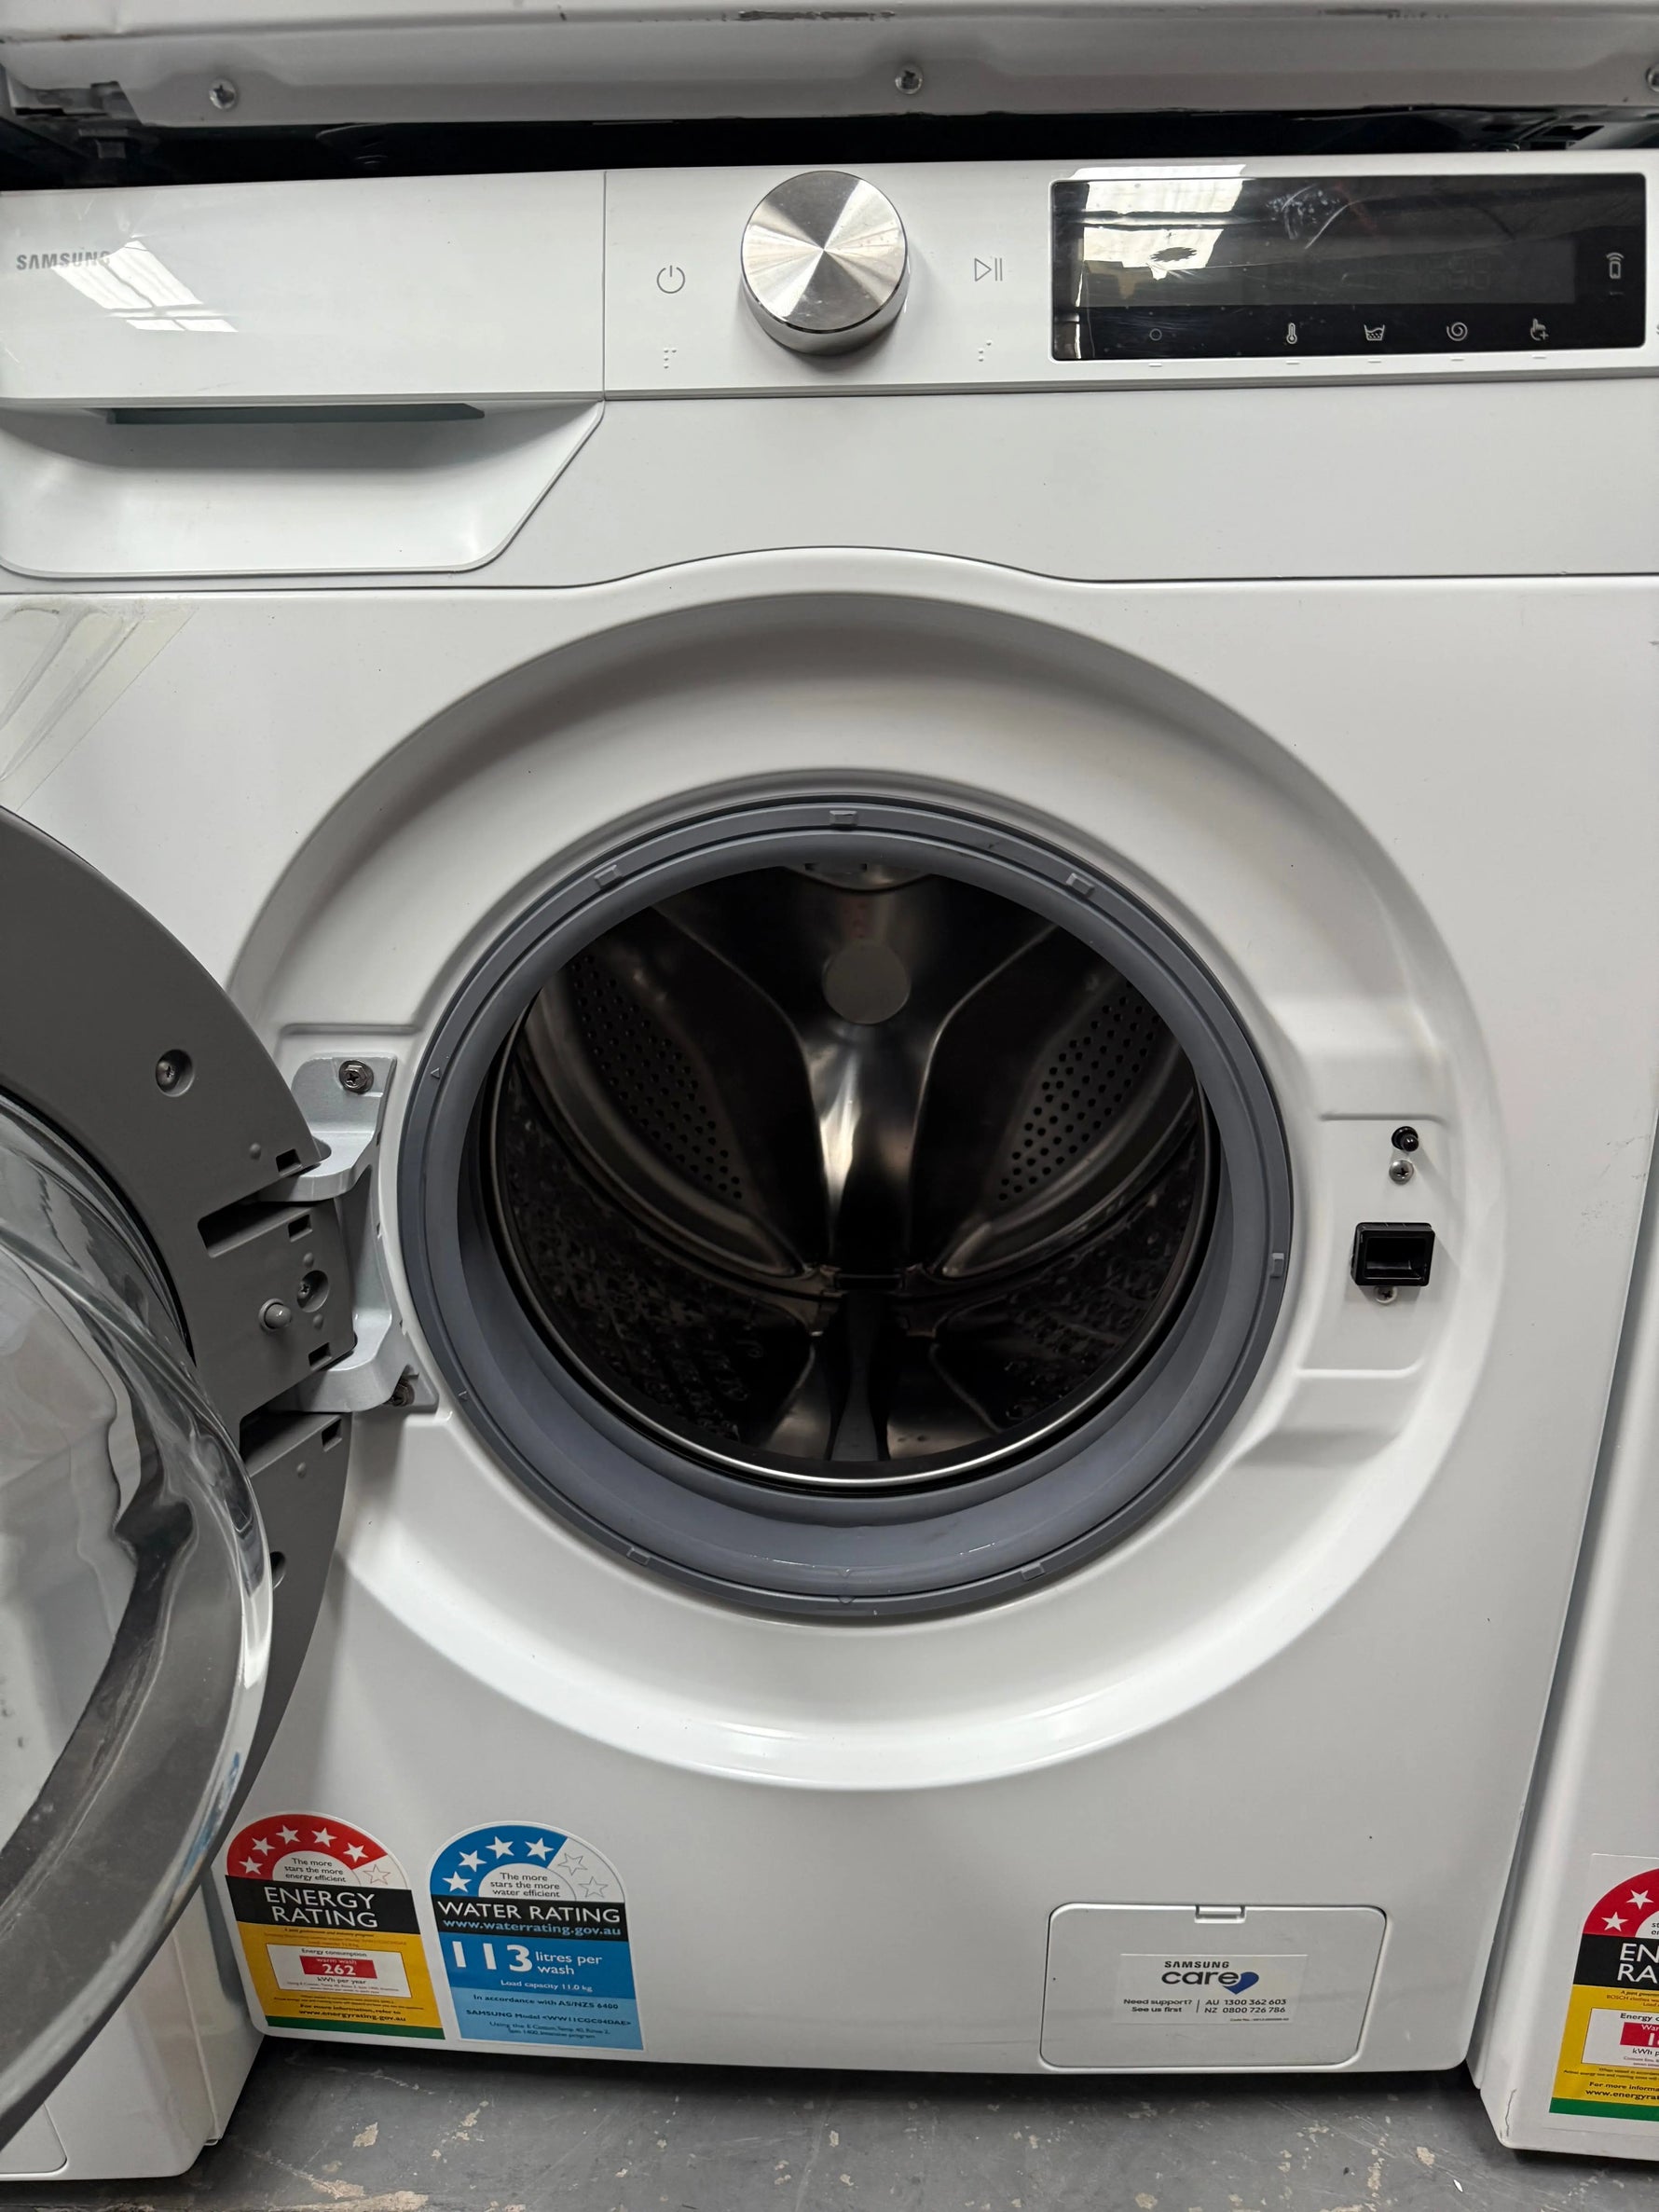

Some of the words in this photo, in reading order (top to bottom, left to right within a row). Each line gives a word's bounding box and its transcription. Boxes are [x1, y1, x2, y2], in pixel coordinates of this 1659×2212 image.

[16, 251, 110, 269] SAMSUNG
[264, 1887, 375, 1909] ENERGY
[271, 1905, 377, 1928] RATING
[437, 1901, 522, 1919] WATER
[529, 1905, 621, 1923] RATING
[443, 1918, 621, 1936] www.waterrating.gov.au
[536, 1952, 572, 1963] litres
[577, 1955, 603, 1967] per
[1164, 1960, 1229, 1969] SAMSUNG
[322, 1964, 356, 1975] 262
[538, 1965, 574, 1975] wash
[1617, 1963, 1658, 1984] RA
[1161, 1972, 1239, 1985] care
[525, 1982, 558, 1990] capacity
[466, 2010, 513, 2018] SAMSUNG
[1620, 2013, 1652, 2022] Energy
[1648, 2032, 1659, 2046] 1
